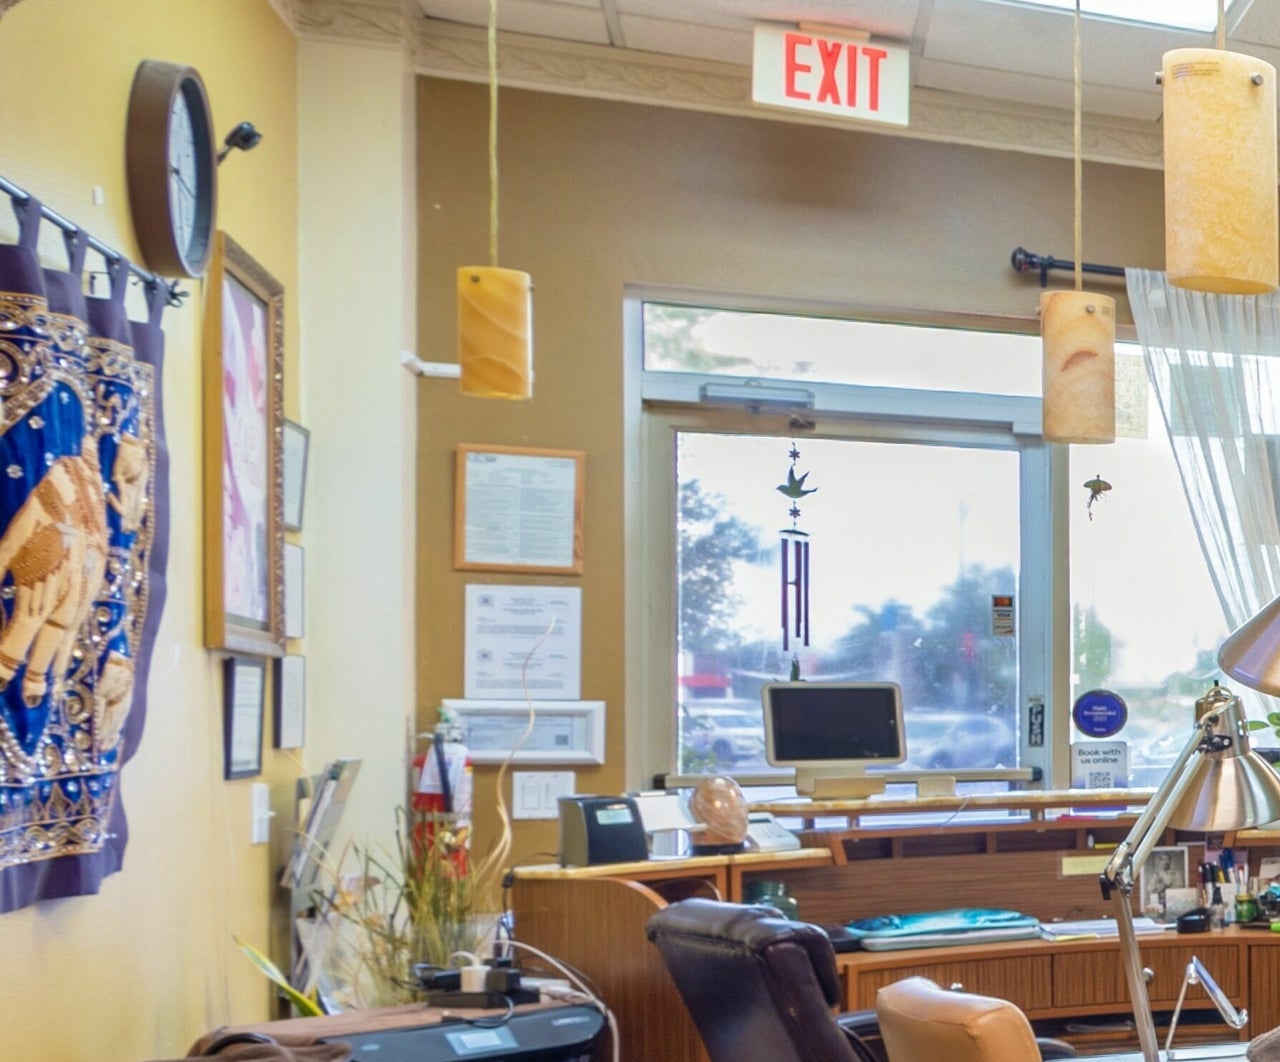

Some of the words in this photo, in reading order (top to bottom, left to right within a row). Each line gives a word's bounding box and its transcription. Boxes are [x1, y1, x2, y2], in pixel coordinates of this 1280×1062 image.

[785, 33, 887, 111] EXIT
[1031, 704, 1043, 746] PUSH
[1092, 756, 1118, 764] online
[1102, 748, 1121, 756] with
